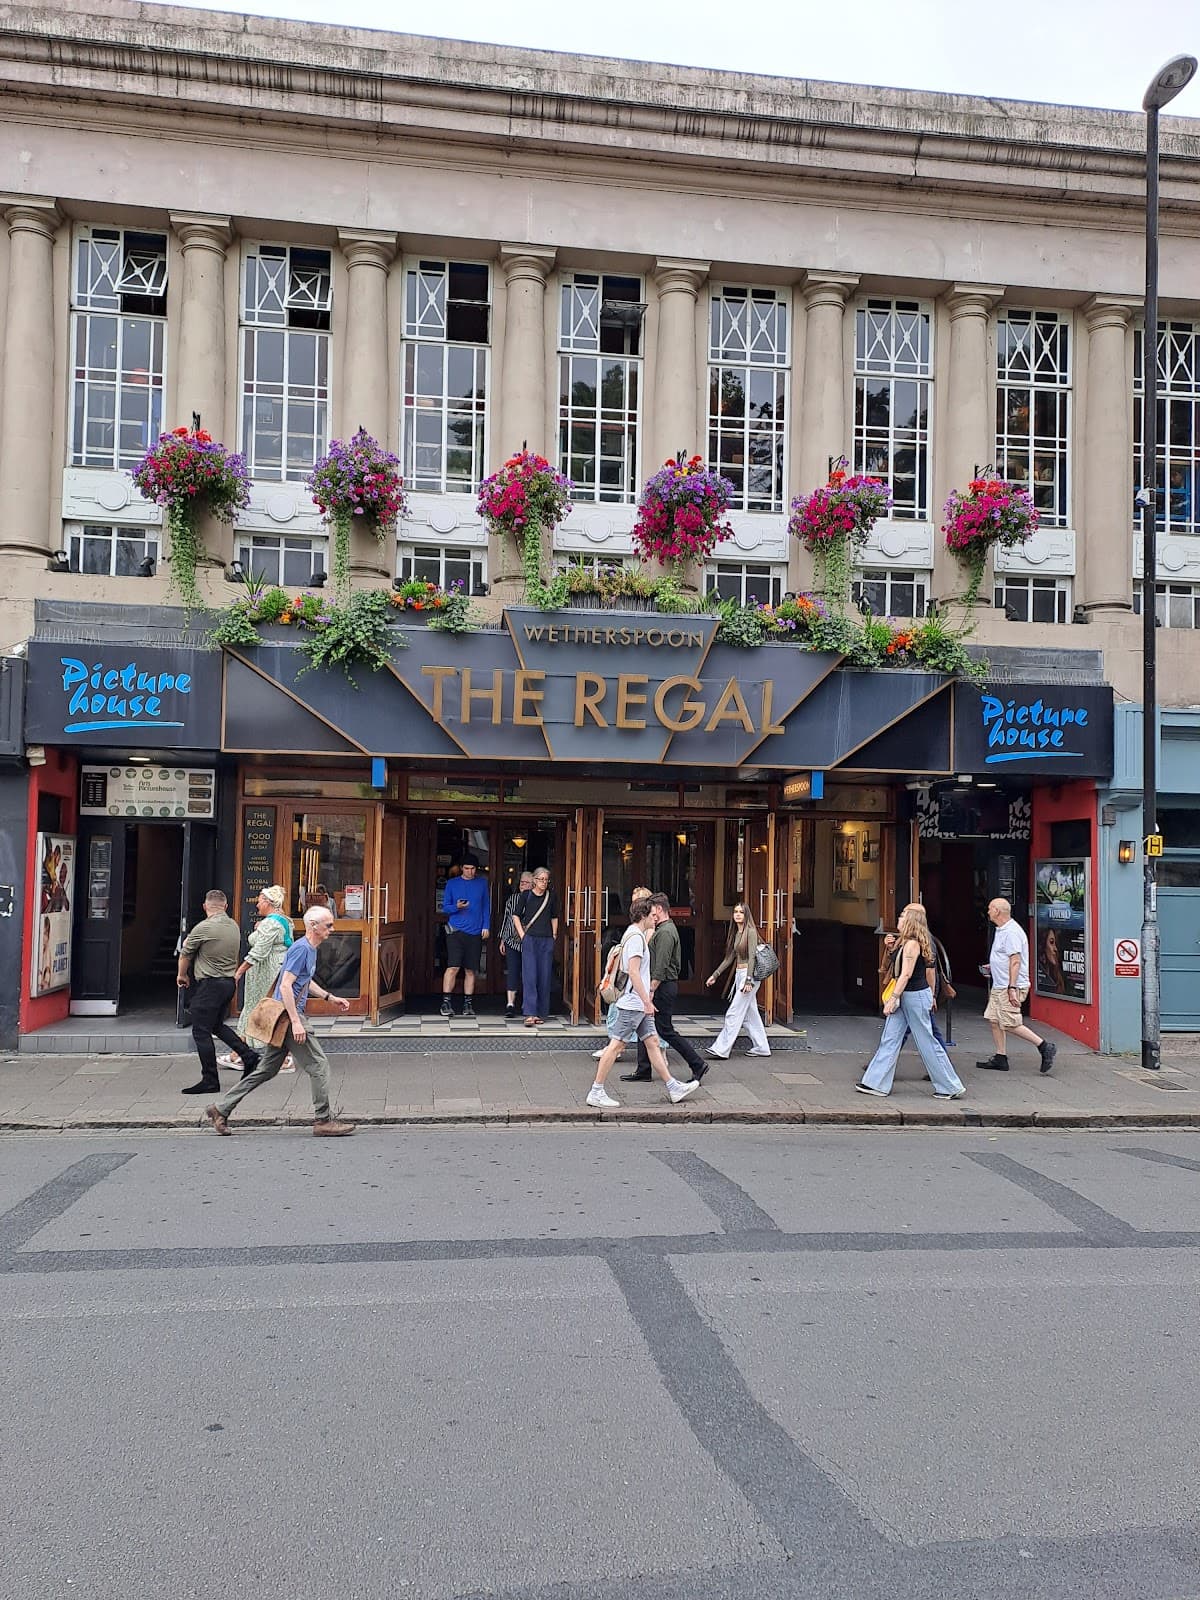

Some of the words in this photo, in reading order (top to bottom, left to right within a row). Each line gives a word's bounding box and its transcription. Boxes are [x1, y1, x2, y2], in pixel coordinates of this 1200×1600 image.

[523, 624, 704, 649] WETHERSPOON
[60, 657, 191, 694] Picture
[69, 682, 161, 718] house
[420, 665, 546, 727] THE
[574, 671, 785, 735] REGAL
[981, 694, 1089, 728] Picture
[988, 717, 1064, 749] house
[246, 819, 273, 827] REGAL
[1150, 837, 1161, 854] H
[53, 958, 68, 973] PLANET
[1062, 961, 1077, 973] WITH
[1076, 963, 1085, 974] US
[1063, 950, 1070, 960] IT
[1069, 951, 1085, 963] ENDS
